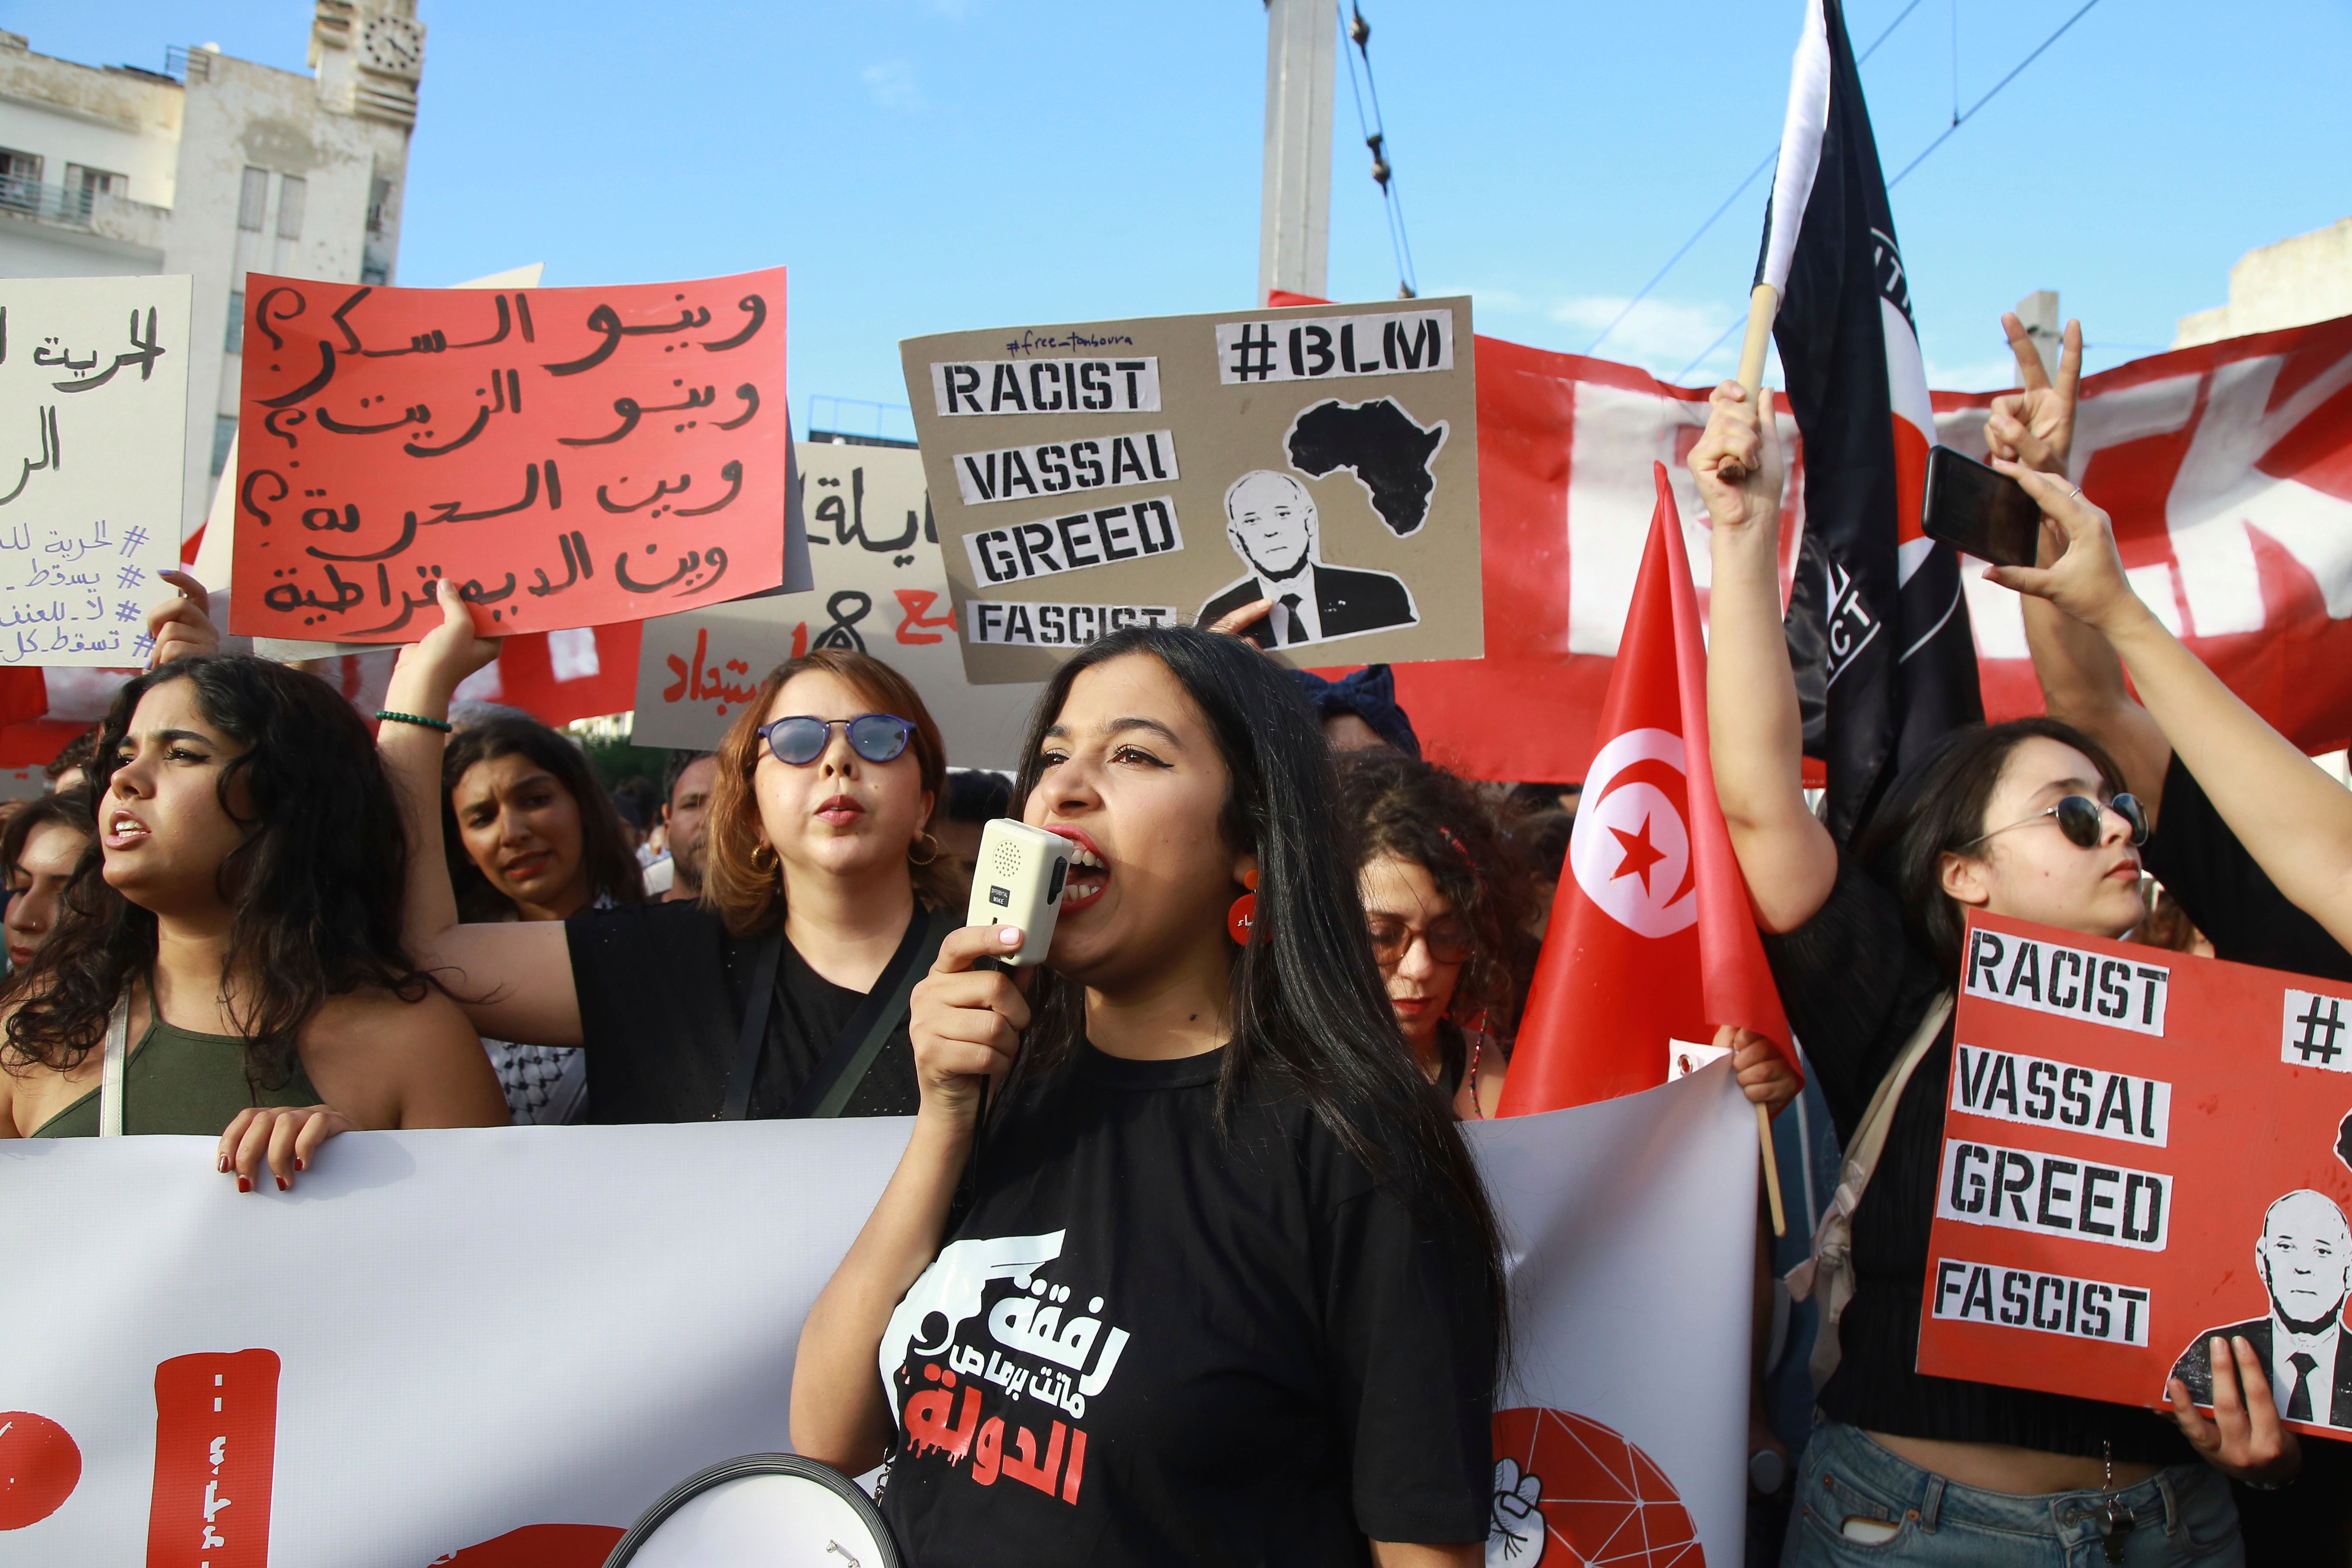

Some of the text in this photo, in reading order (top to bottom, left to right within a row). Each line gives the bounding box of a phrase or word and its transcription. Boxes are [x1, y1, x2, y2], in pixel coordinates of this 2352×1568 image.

[539, 294, 766, 376] وينو
[1231, 319, 1441, 382] #BLM
[557, 379, 760, 449] وينو
[943, 362, 1145, 413] RACIST
[597, 459, 743, 518] وين
[616, 543, 727, 597] وين
[976, 499, 1175, 582] GREED
[1967, 931, 2168, 1026] RACIST
[1951, 1143, 2163, 1243] GREED
[988, 1275, 1131, 1396] رفقة
[1934, 1262, 2147, 1343] FASCIST
[948, 1344, 1086, 1419] ماتت برصاص
[904, 1363, 1087, 1506] الدولة
